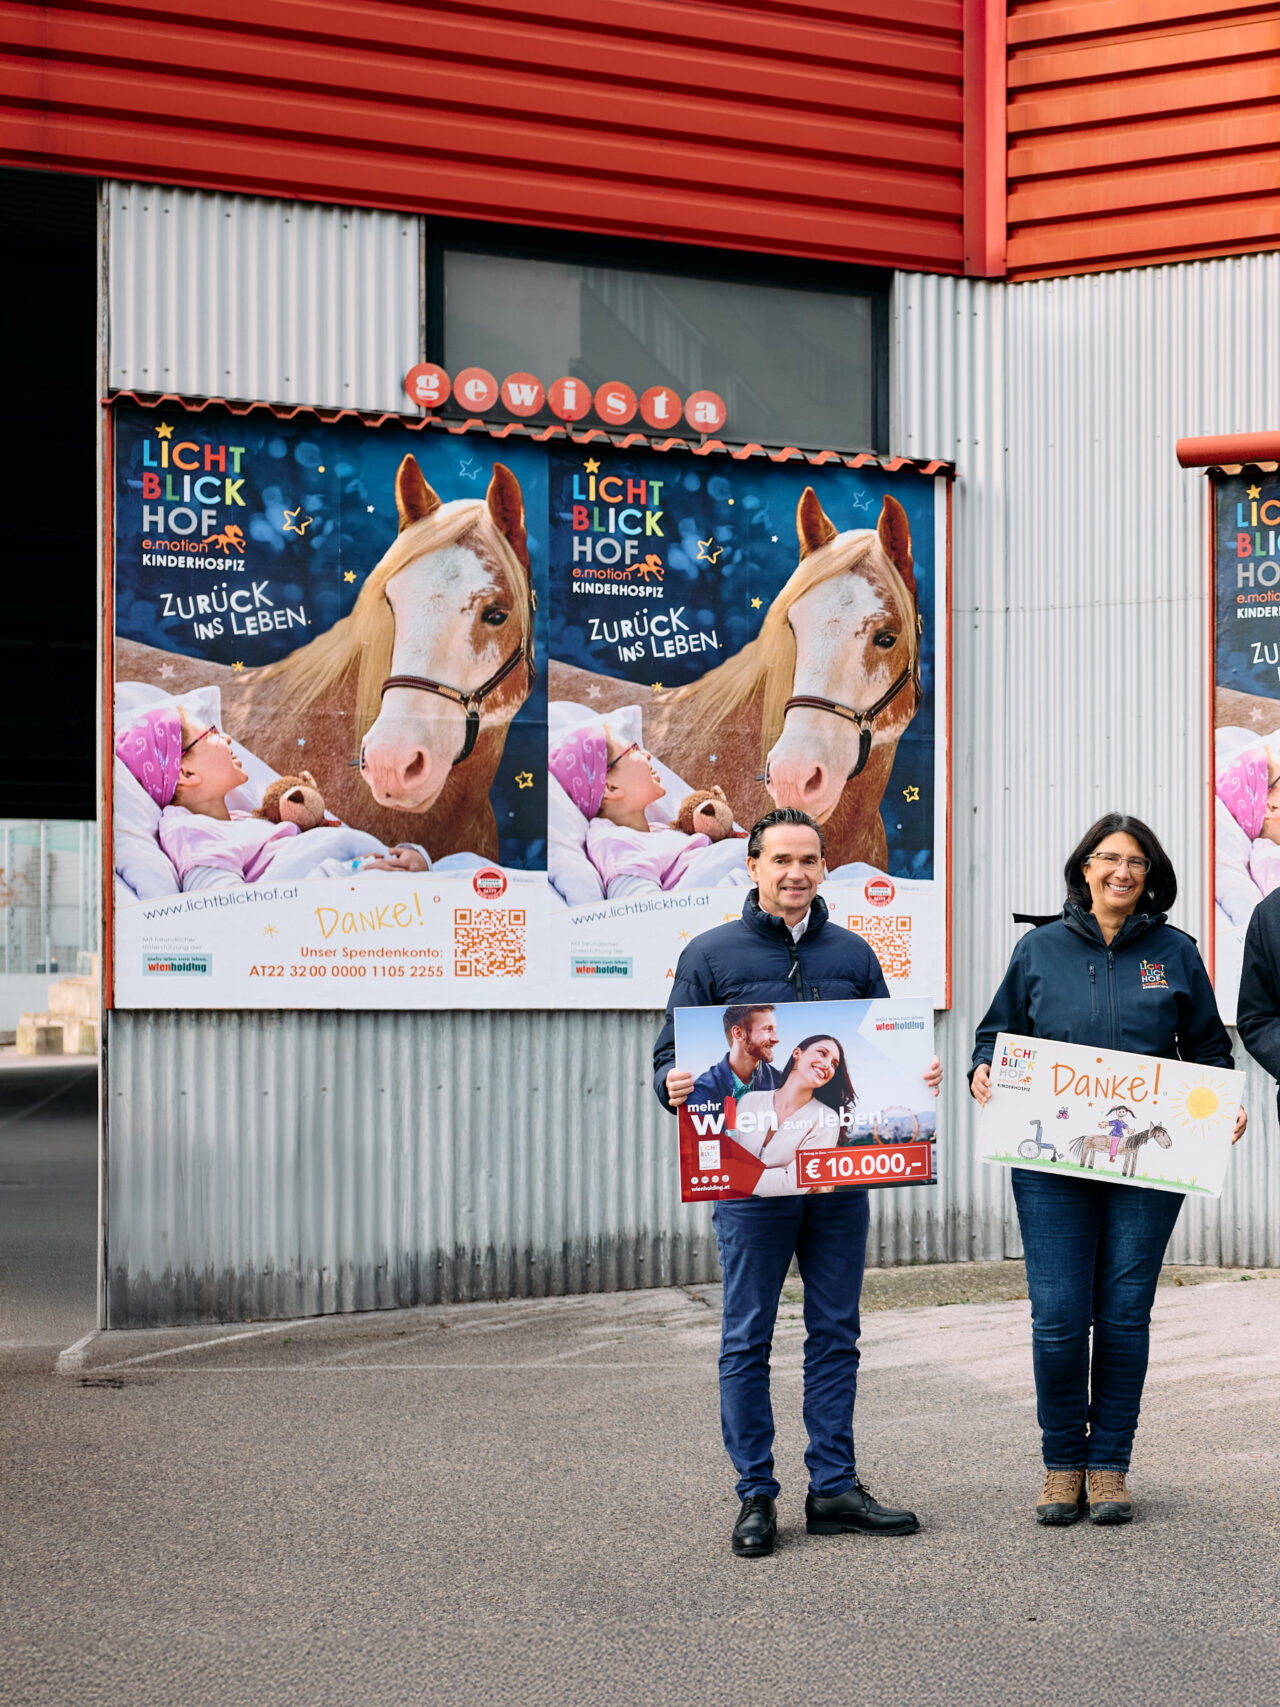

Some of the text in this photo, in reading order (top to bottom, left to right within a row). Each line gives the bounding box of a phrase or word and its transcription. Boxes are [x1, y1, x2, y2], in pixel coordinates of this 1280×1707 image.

[416, 373, 720, 425] gewista
[143, 440, 245, 473] LICHT
[142, 472, 246, 506] BLICK
[572, 474, 664, 506] LICHT
[142, 505, 217, 536] HOF
[572, 504, 665, 537] BLICK
[142, 538, 208, 553] e.motion
[572, 535, 639, 565] HOF
[143, 554, 245, 571] KINDERHOSPIZ
[572, 567, 631, 581] e.motion
[572, 582, 664, 598] KINDERHOSPIZ
[160, 580, 274, 619] ZURÜCK
[194, 606, 311, 640] INS LEBEN.
[588, 606, 689, 643] ZURÜCK
[618, 630, 723, 662] INS LEBEN.
[143, 887, 298, 920] www.lichtblickhof.at
[571, 895, 710, 925] www.lichtblickhof.at
[301, 946, 444, 960] Unser Spendenkonto:
[148, 962, 207, 973] wienholding
[249, 965, 443, 977] AT22 3200 0000 1105 2255
[576, 965, 628, 975] wienholding
[1140, 969, 1166, 978] BLICK
[1141, 975, 1161, 983] HOF
[876, 1021, 925, 1031] wienholding
[1003, 1046, 1037, 1060] LICHT
[1001, 1057, 1035, 1071] BLICK
[999, 1067, 1025, 1080] HOF
[687, 1100, 722, 1112] mehr
[783, 1119, 813, 1130] zum
[818, 1106, 889, 1128] leben.
[805, 1158, 821, 1179] €
[691, 1184, 730, 1192] wienholding.at
